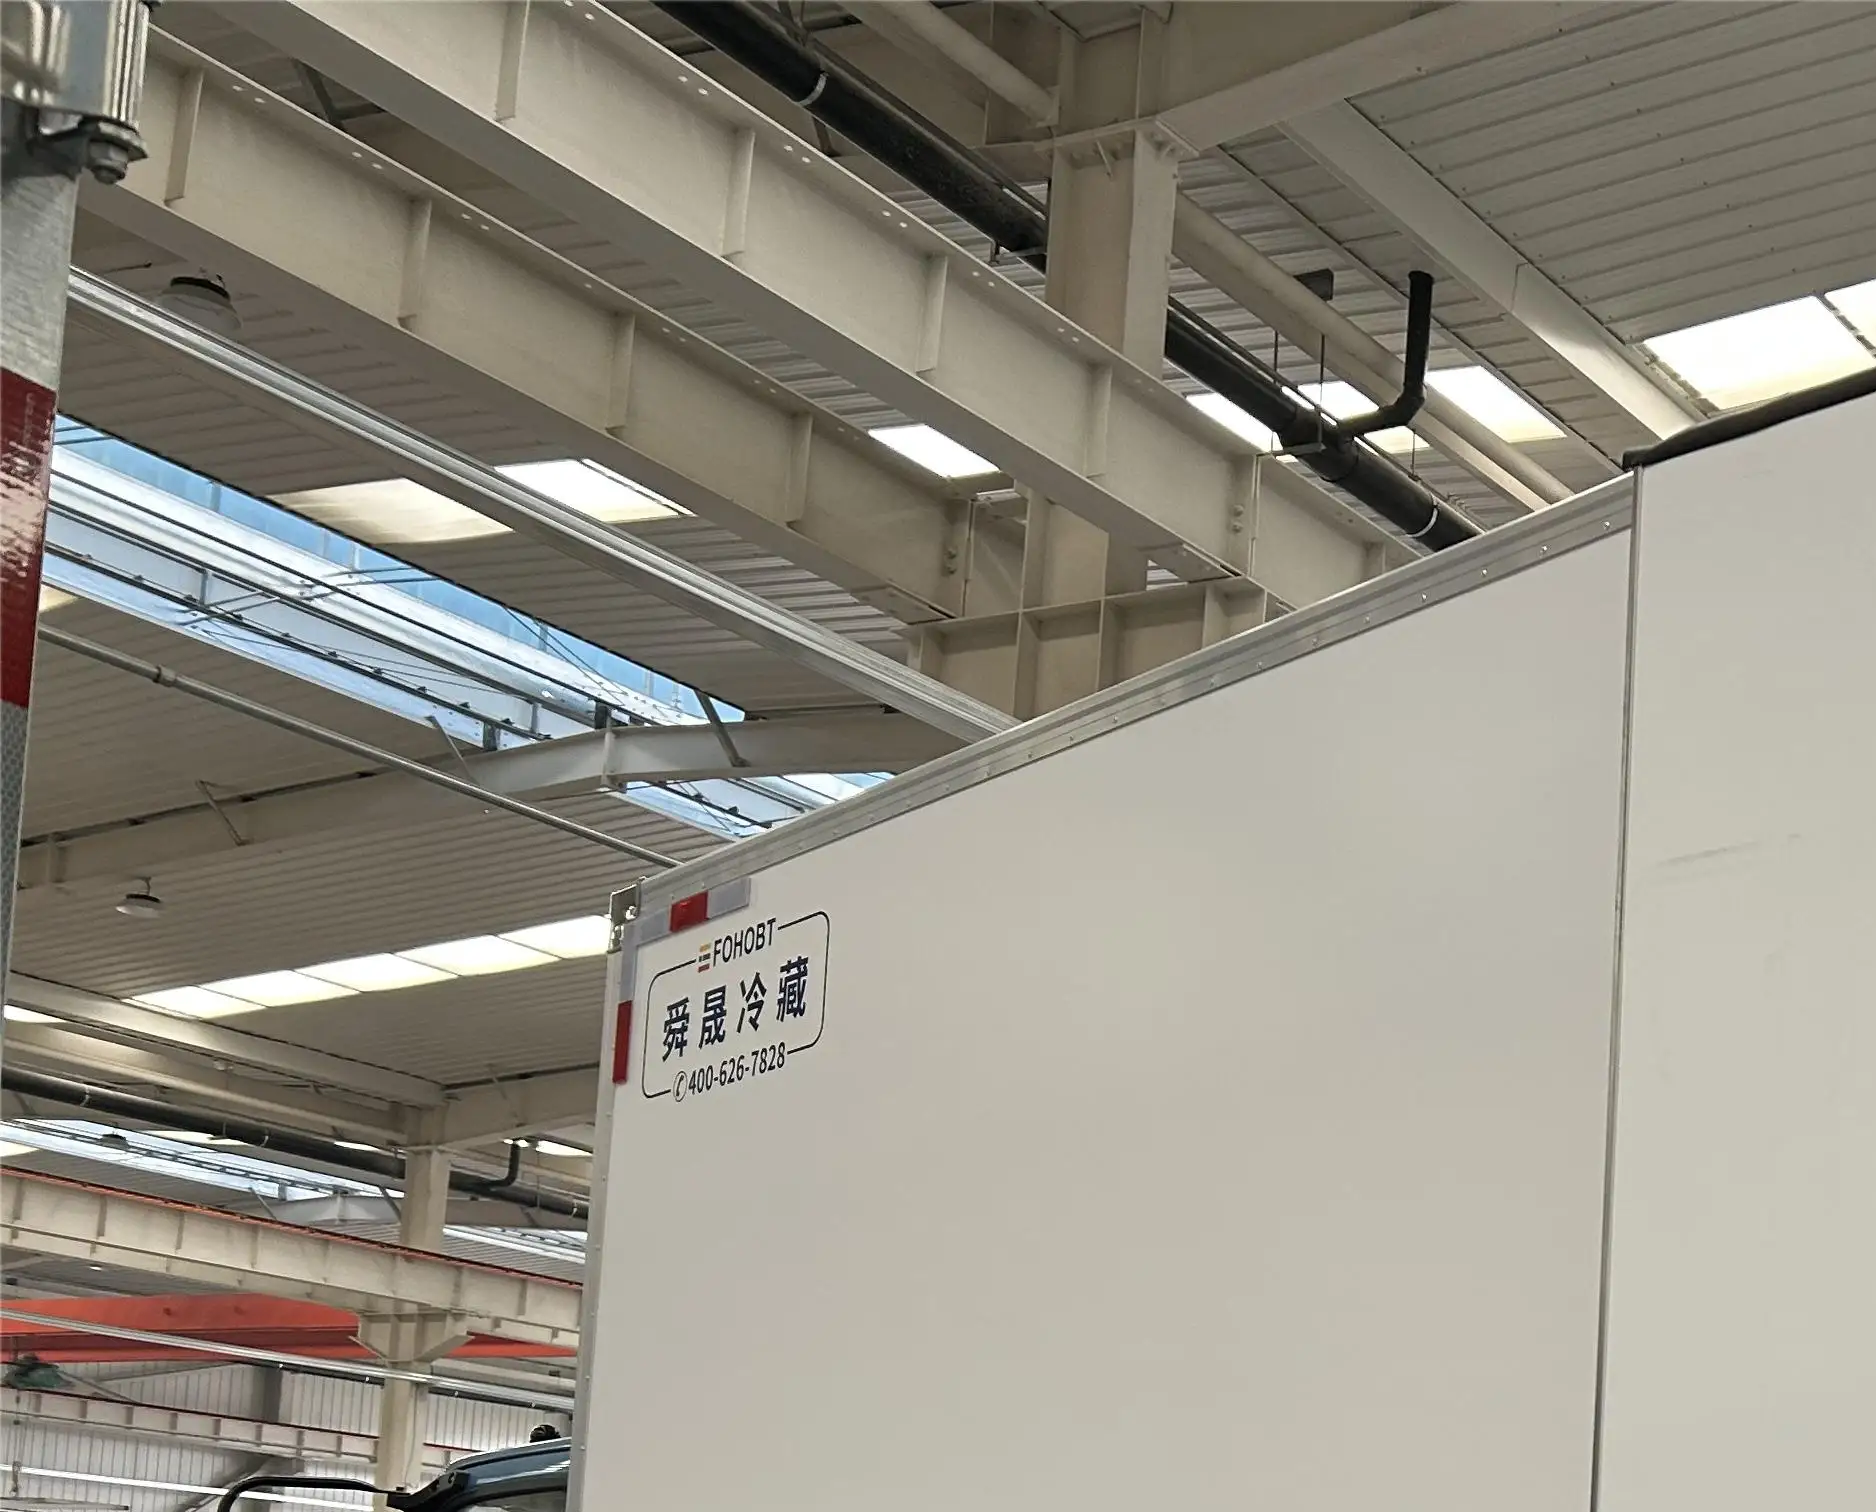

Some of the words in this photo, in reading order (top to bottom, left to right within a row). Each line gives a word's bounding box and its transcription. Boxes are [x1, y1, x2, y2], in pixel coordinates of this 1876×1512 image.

[713, 918, 776, 966] FOHOBT
[662, 956, 808, 1062] 舜晟冷藏
[688, 1042, 786, 1095] 400-626-7828
